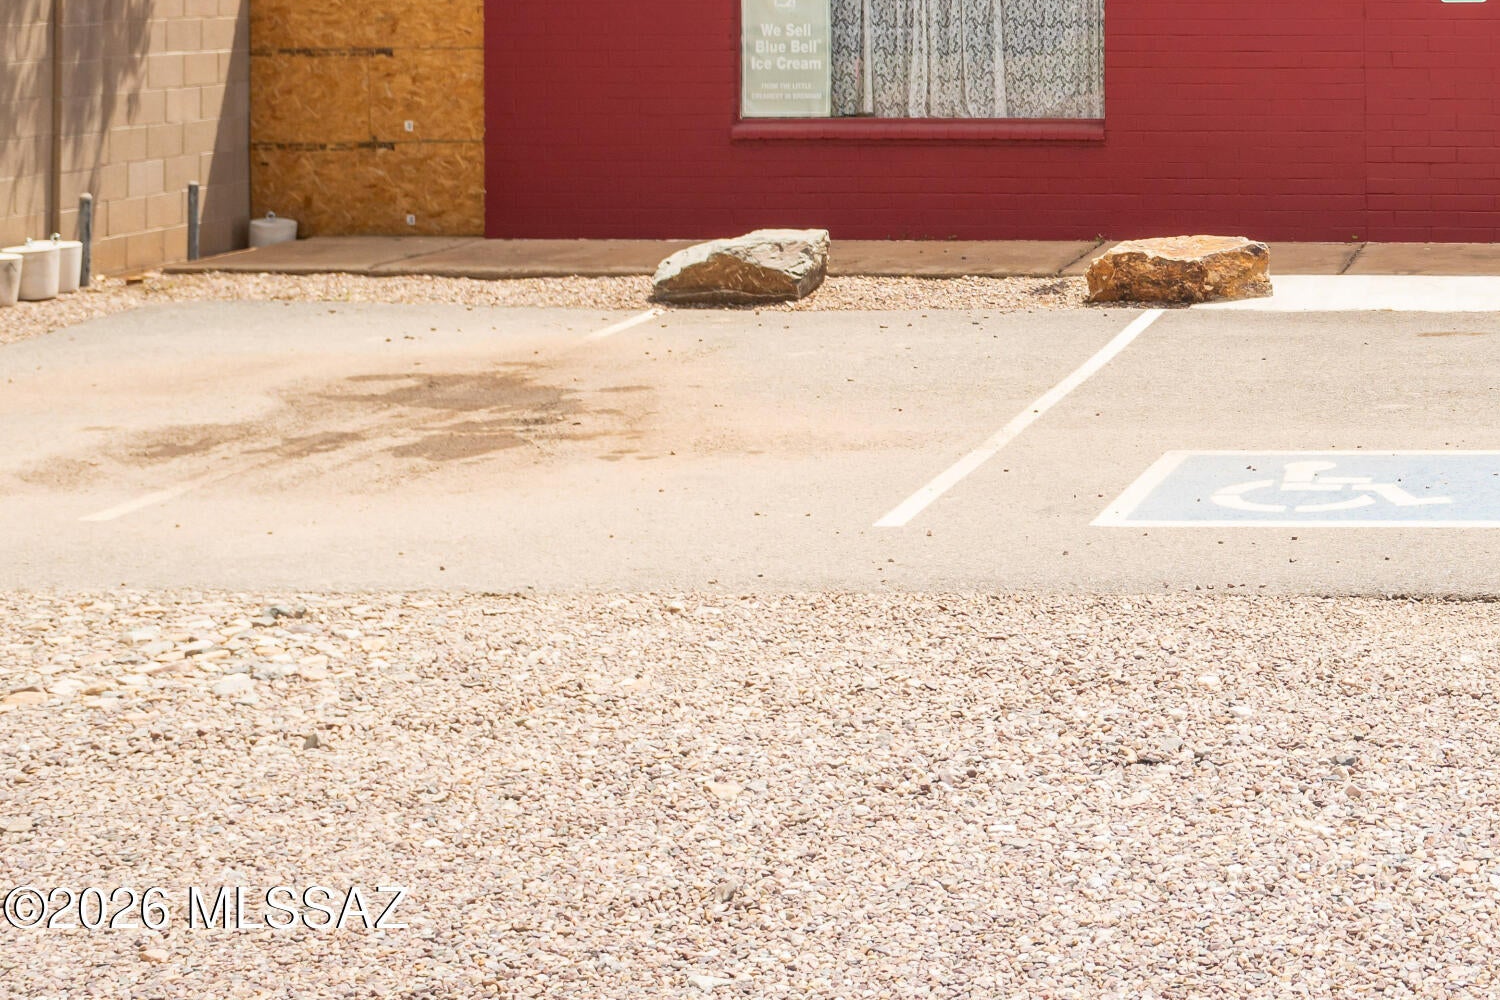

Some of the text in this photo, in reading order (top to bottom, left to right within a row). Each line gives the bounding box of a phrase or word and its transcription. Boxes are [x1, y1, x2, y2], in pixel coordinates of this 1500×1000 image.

[760, 23, 812, 37] We Sell
[755, 40, 786, 53] Blue
[751, 56, 822, 70] Ice Cream
